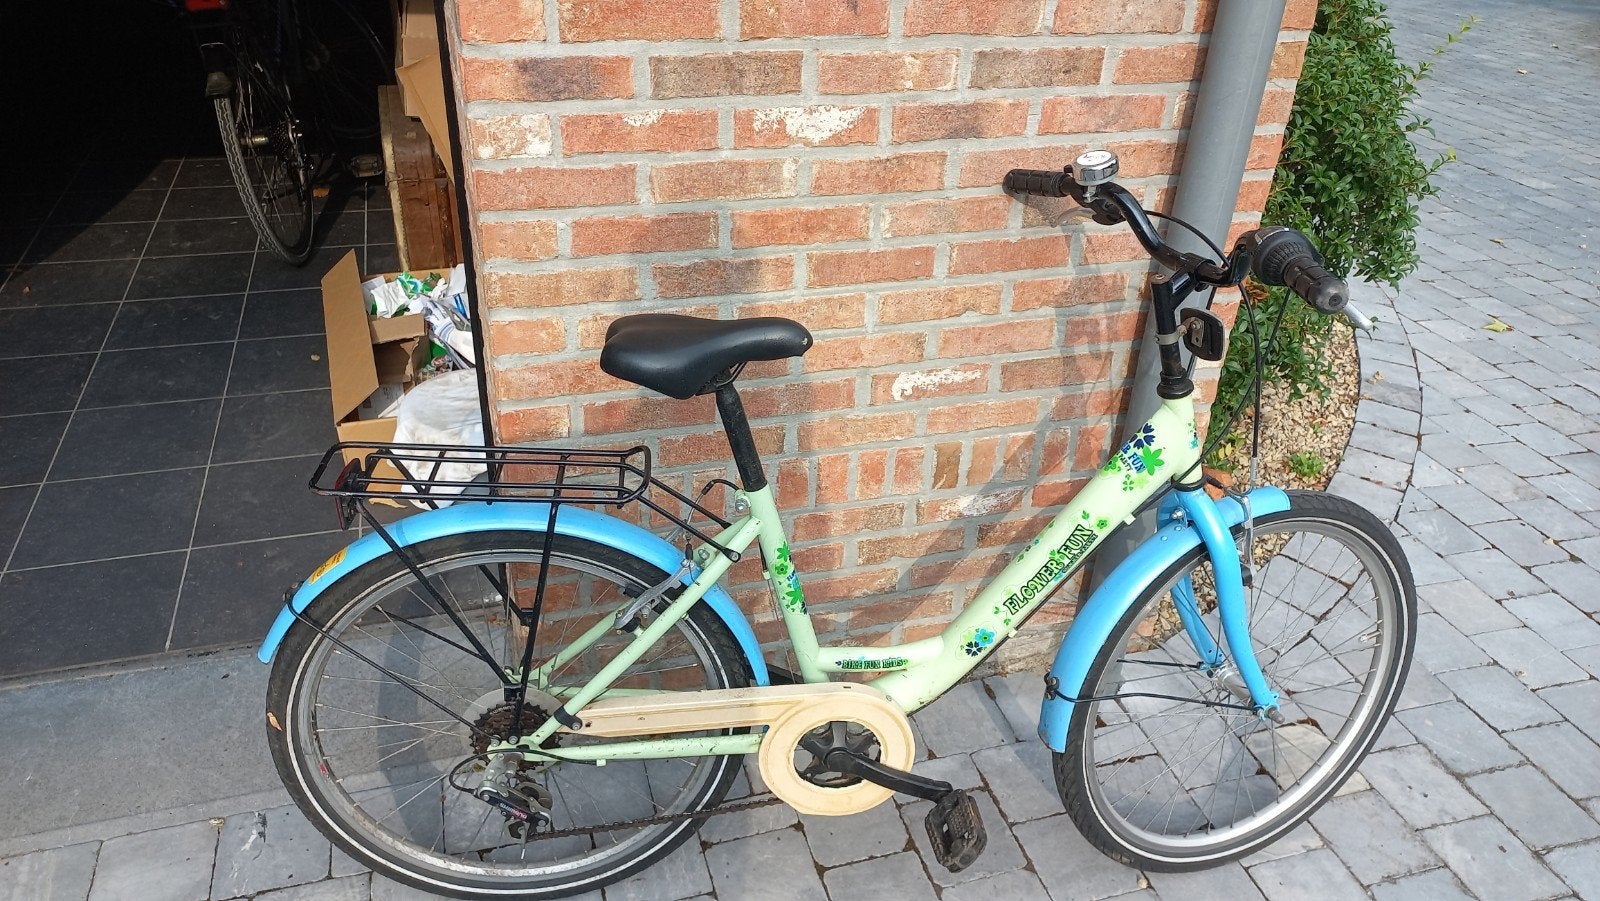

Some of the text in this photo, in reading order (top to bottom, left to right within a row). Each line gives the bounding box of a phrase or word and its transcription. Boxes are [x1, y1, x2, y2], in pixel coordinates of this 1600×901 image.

[1128, 451, 1146, 472] FUN
[1003, 559, 1065, 615] FLOWER
[1057, 524, 1094, 561] FUN
[841, 658, 904, 670] BIKE FUN KIDS
